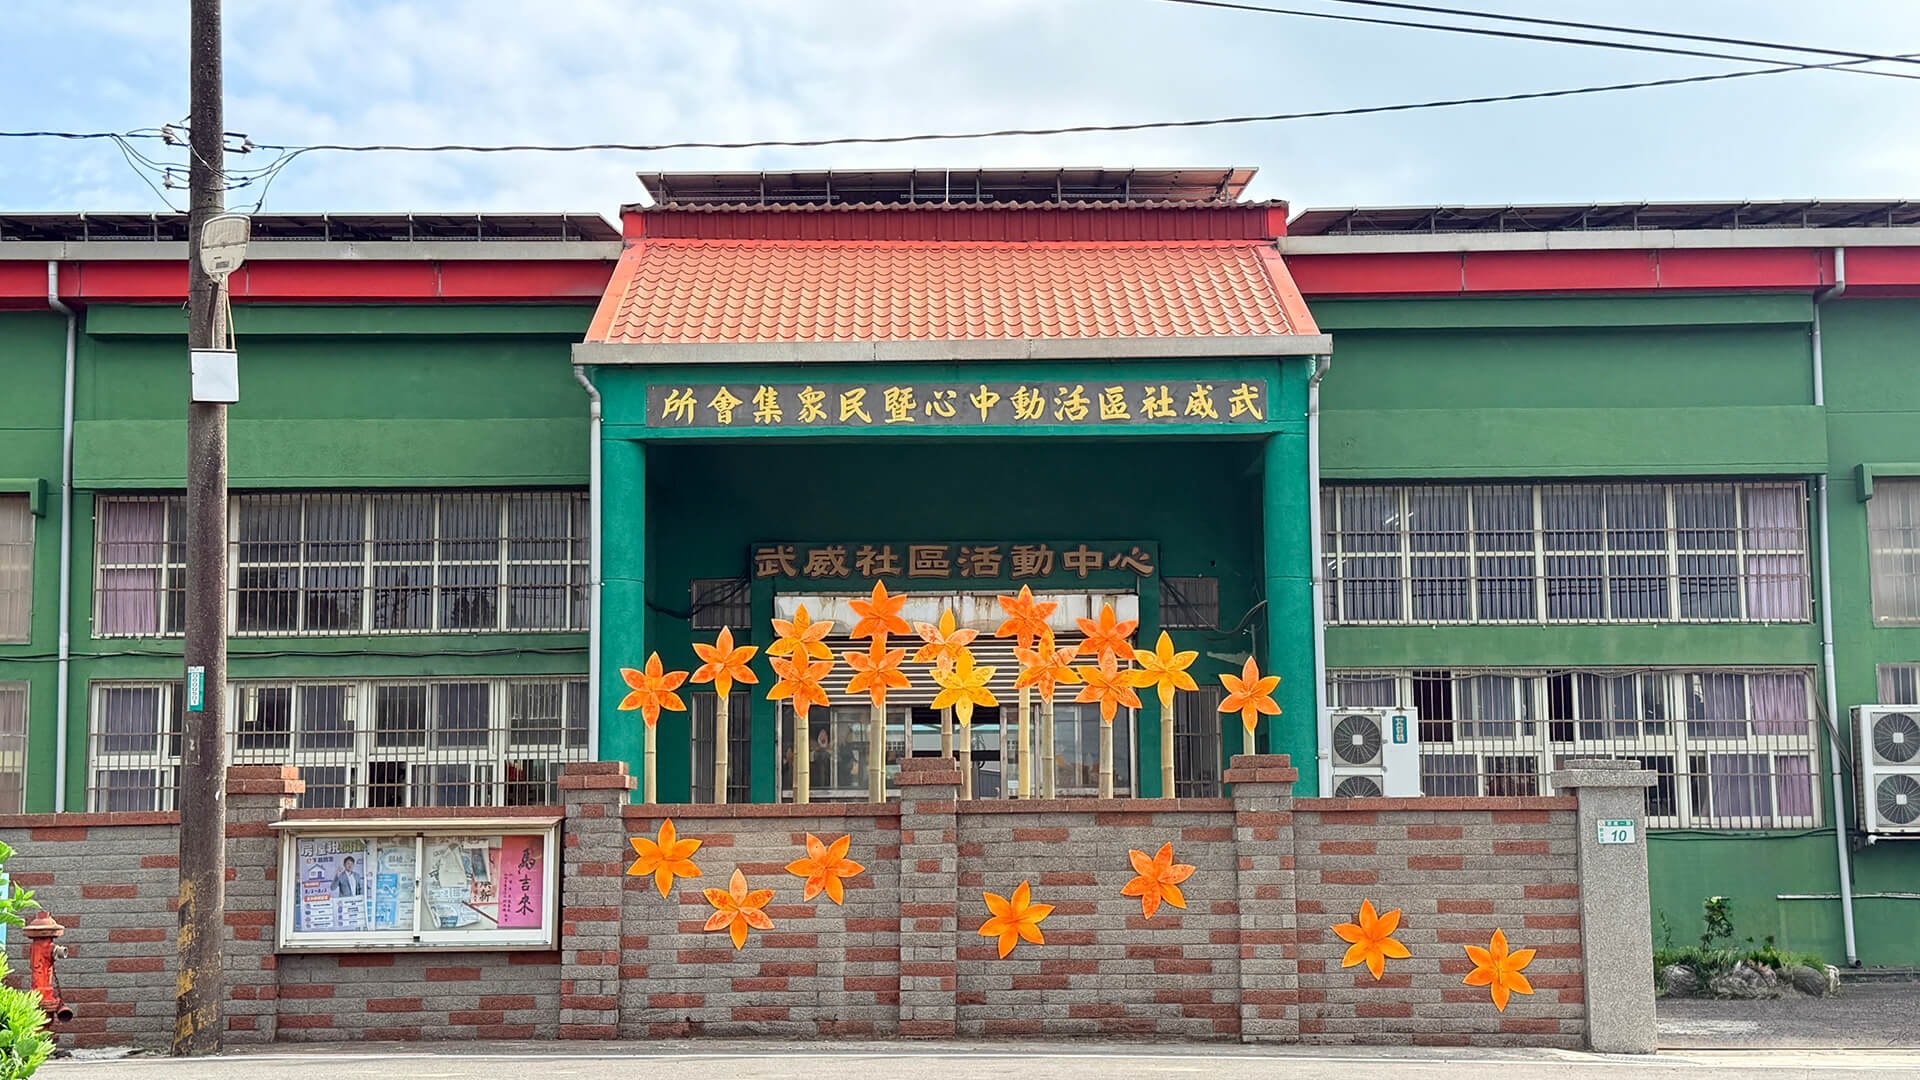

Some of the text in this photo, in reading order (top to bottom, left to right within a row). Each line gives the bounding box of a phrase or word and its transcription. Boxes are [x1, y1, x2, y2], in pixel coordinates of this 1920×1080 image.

[754, 543, 1154, 579] 武威社區活動中心
[1611, 830, 1628, 842] 10
